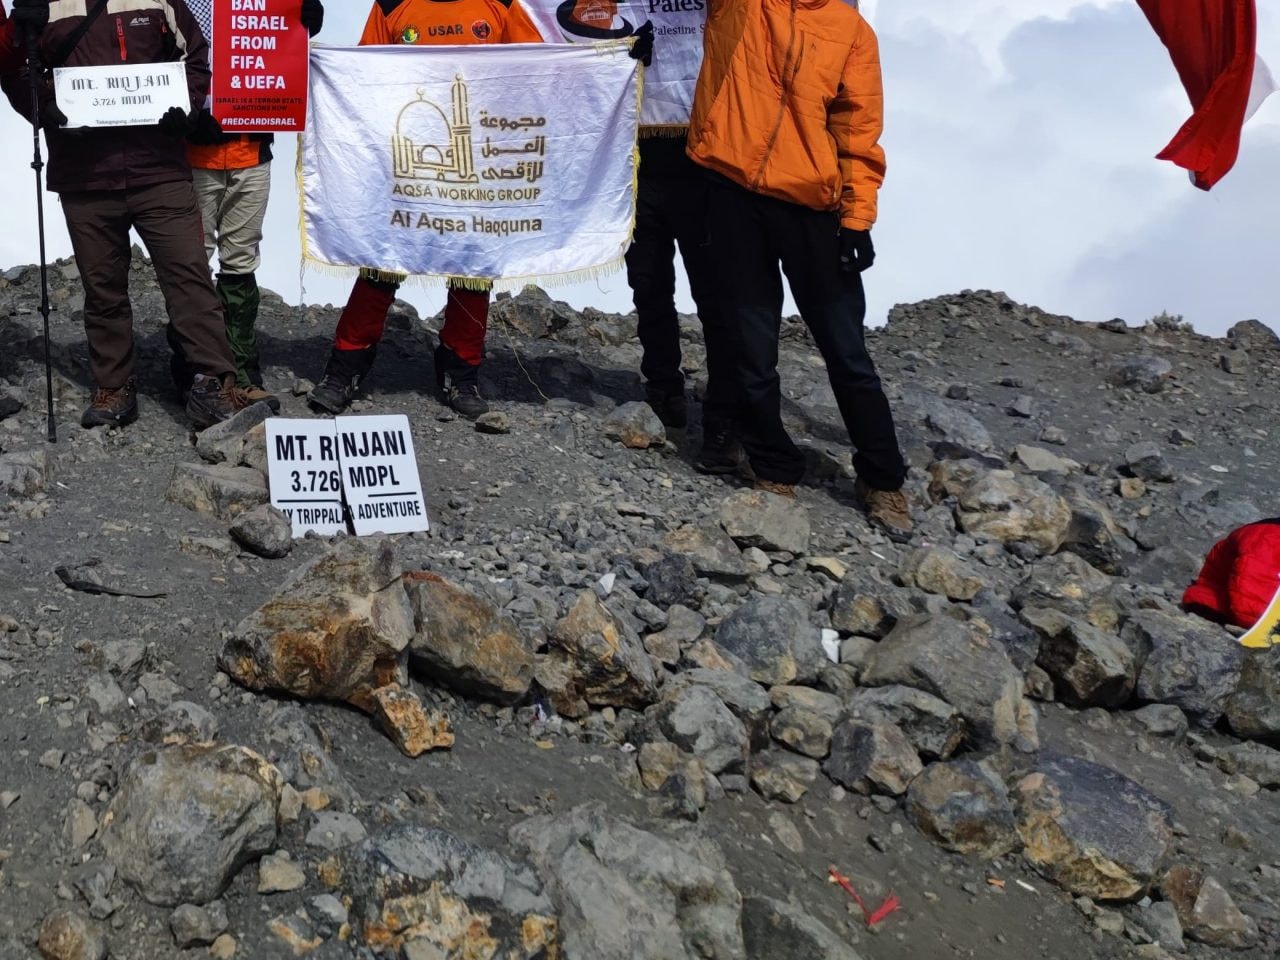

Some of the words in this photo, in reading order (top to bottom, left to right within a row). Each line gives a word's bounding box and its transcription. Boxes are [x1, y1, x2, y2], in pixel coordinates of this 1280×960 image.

[231, 15, 289, 31] ISRAEL
[428, 24, 464, 37] USAR
[231, 35, 276, 50] FROM
[230, 55, 266, 70] FIFA
[230, 75, 242, 89] &
[244, 75, 286, 90] UEFA
[92, 97, 117, 107] 3.726
[221, 117, 297, 126] #REDCARDISRAEL
[479, 110, 547, 131] مجموعة
[481, 160, 544, 183] للأقصى
[392, 183, 433, 197] AQSA
[436, 186, 496, 201] WORKING
[498, 188, 541, 201] GROUP
[416, 212, 467, 235] Aqsa
[472, 214, 543, 237] Haqquna
[275, 434, 313, 461] MT.
[319, 430, 407, 461] RINJANI
[290, 470, 340, 492] 3.726
[348, 464, 400, 488] MDPL
[358, 500, 422, 520] ADVENTURE
